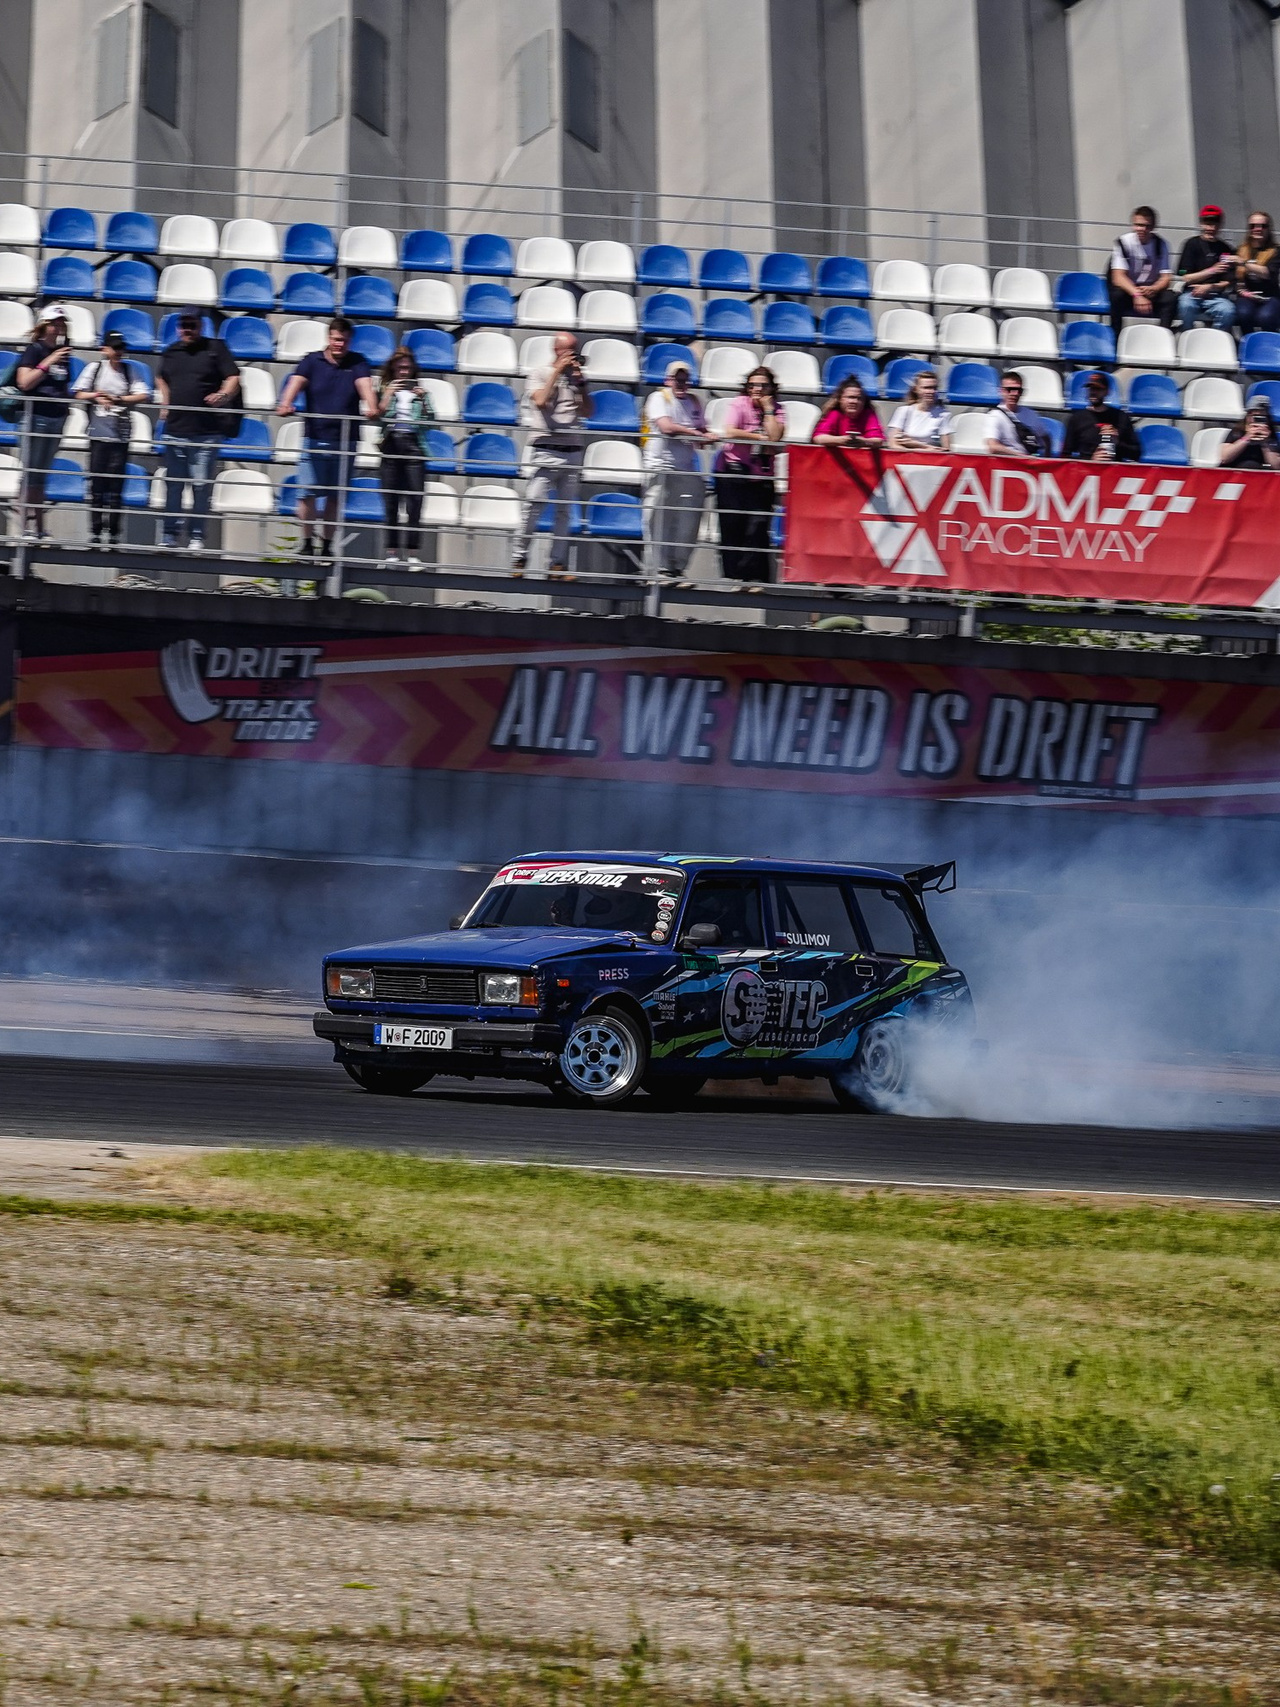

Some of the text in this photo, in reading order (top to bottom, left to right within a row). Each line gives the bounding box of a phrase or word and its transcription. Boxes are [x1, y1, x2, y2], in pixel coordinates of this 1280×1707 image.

[939, 467, 1101, 524] ADM
[937, 520, 1158, 563] RACEWAY
[205, 647, 323, 678] DRIFT
[491, 668, 1158, 786] ALL WE NEED IS DRIFT
[786, 932, 831, 946] SULIMOV
[598, 968, 629, 980] PRESS
[414, 1030, 446, 1046] 2009
